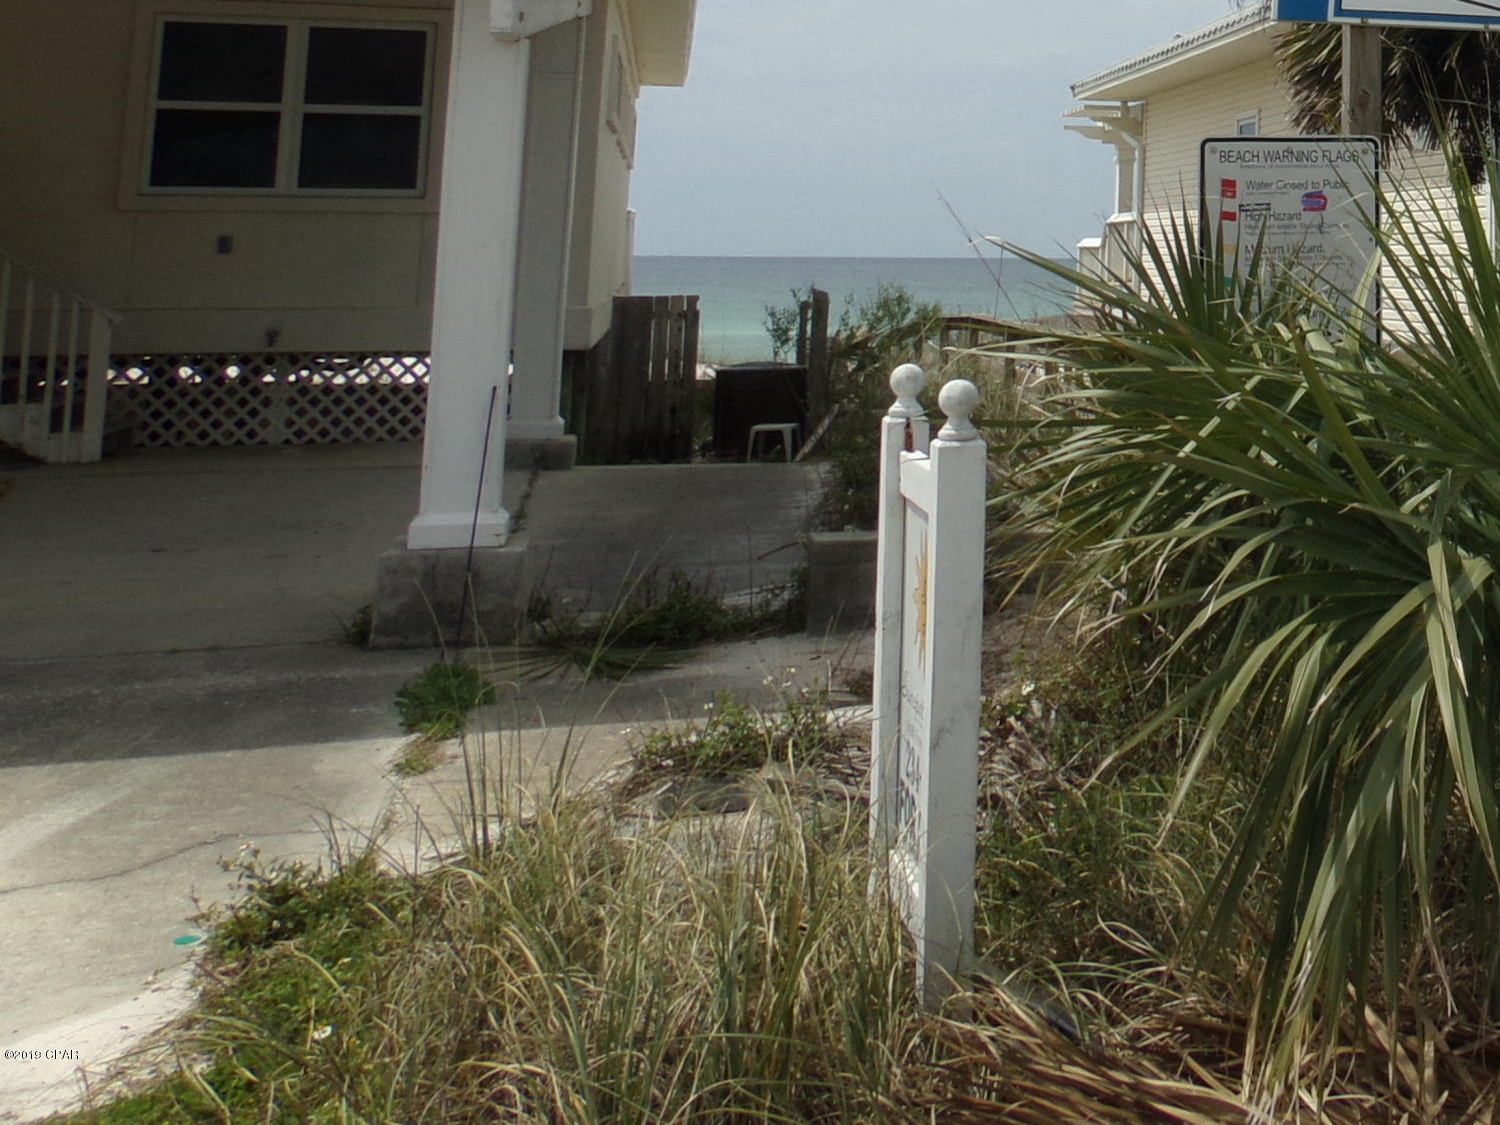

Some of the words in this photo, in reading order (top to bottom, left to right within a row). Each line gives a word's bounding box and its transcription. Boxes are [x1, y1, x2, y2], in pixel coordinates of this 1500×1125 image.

[1219, 150, 1260, 164] BEACH
[1263, 150, 1318, 164] WARNING
[1321, 150, 1360, 164] FLAGS
[1245, 179, 1273, 191] Water
[1311, 179, 1319, 190] to
[1268, 210, 1302, 222] Hazard
